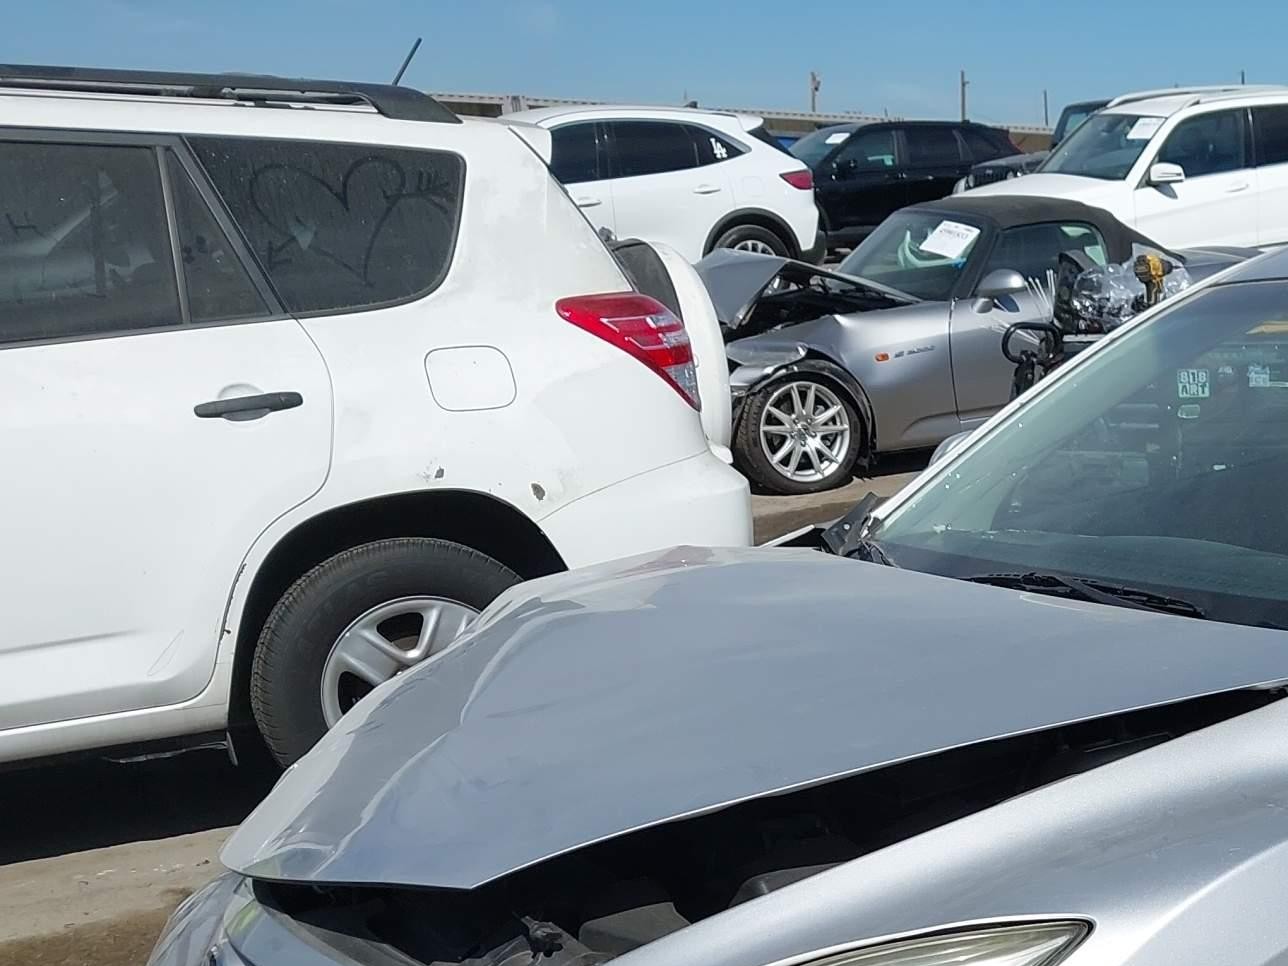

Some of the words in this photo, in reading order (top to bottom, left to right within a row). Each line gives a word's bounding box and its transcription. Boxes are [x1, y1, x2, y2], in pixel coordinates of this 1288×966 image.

[709, 137, 728, 159] LA
[1180, 371, 1206, 383] 818
[1181, 384, 1207, 395] ART
